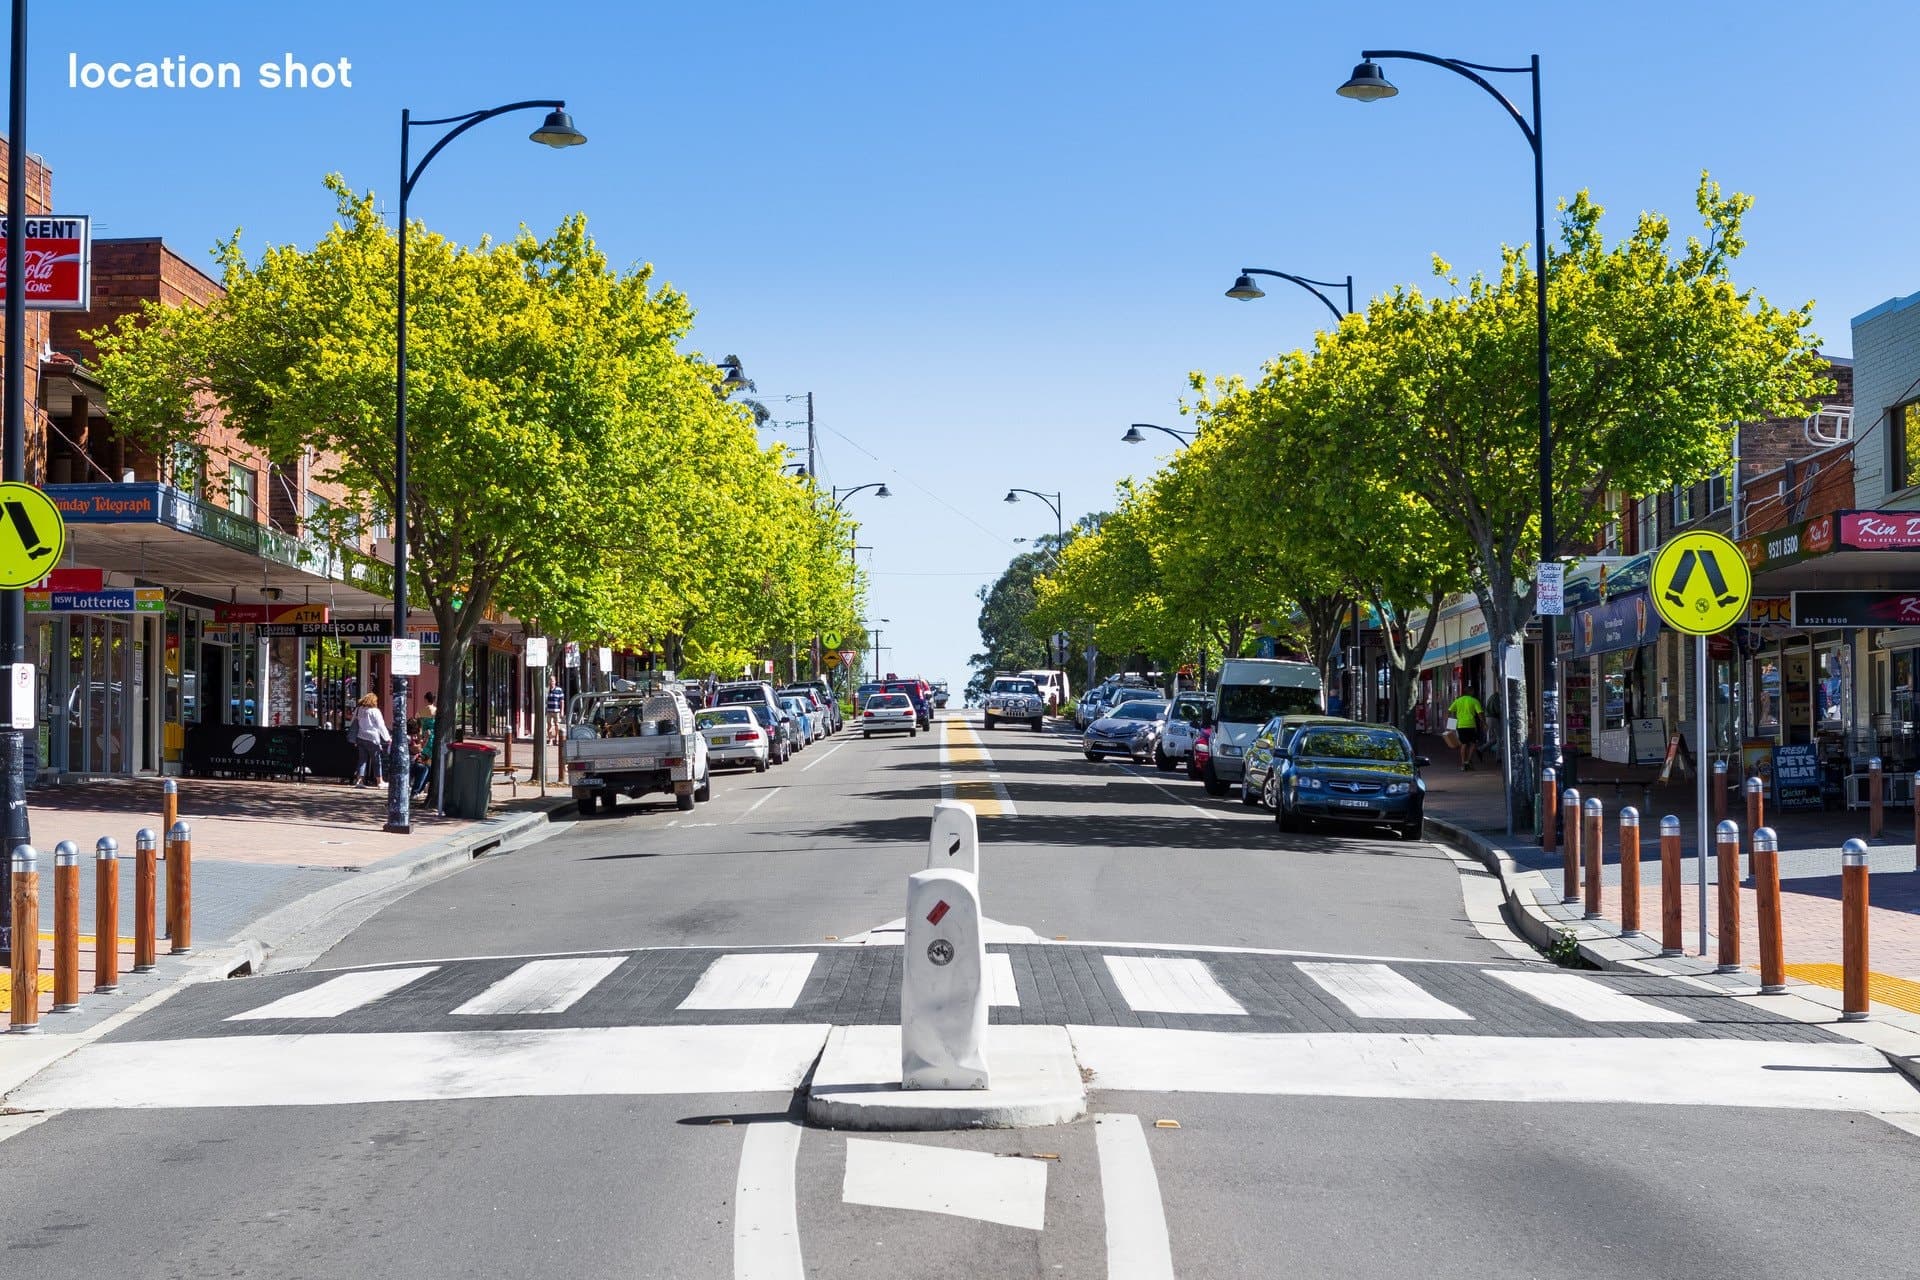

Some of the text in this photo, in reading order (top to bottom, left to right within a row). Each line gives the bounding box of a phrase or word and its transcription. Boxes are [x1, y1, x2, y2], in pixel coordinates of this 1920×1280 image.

[0, 220, 76, 239] SGENT
[25, 280, 52, 293] Coke
[52, 496, 151, 514] unday Telegraph
[1857, 517, 1898, 536] Kin
[1768, 540, 1782, 560] 9521
[1783, 535, 1798, 555] 8500
[73, 596, 130, 608] Lotteries
[295, 611, 320, 621] ATM
[302, 623, 380, 632] ESPRESSO BAR
[1780, 746, 1808, 755] FRESH
[1776, 755, 1816, 766] PETS
[1778, 766, 1816, 777] MEAT
